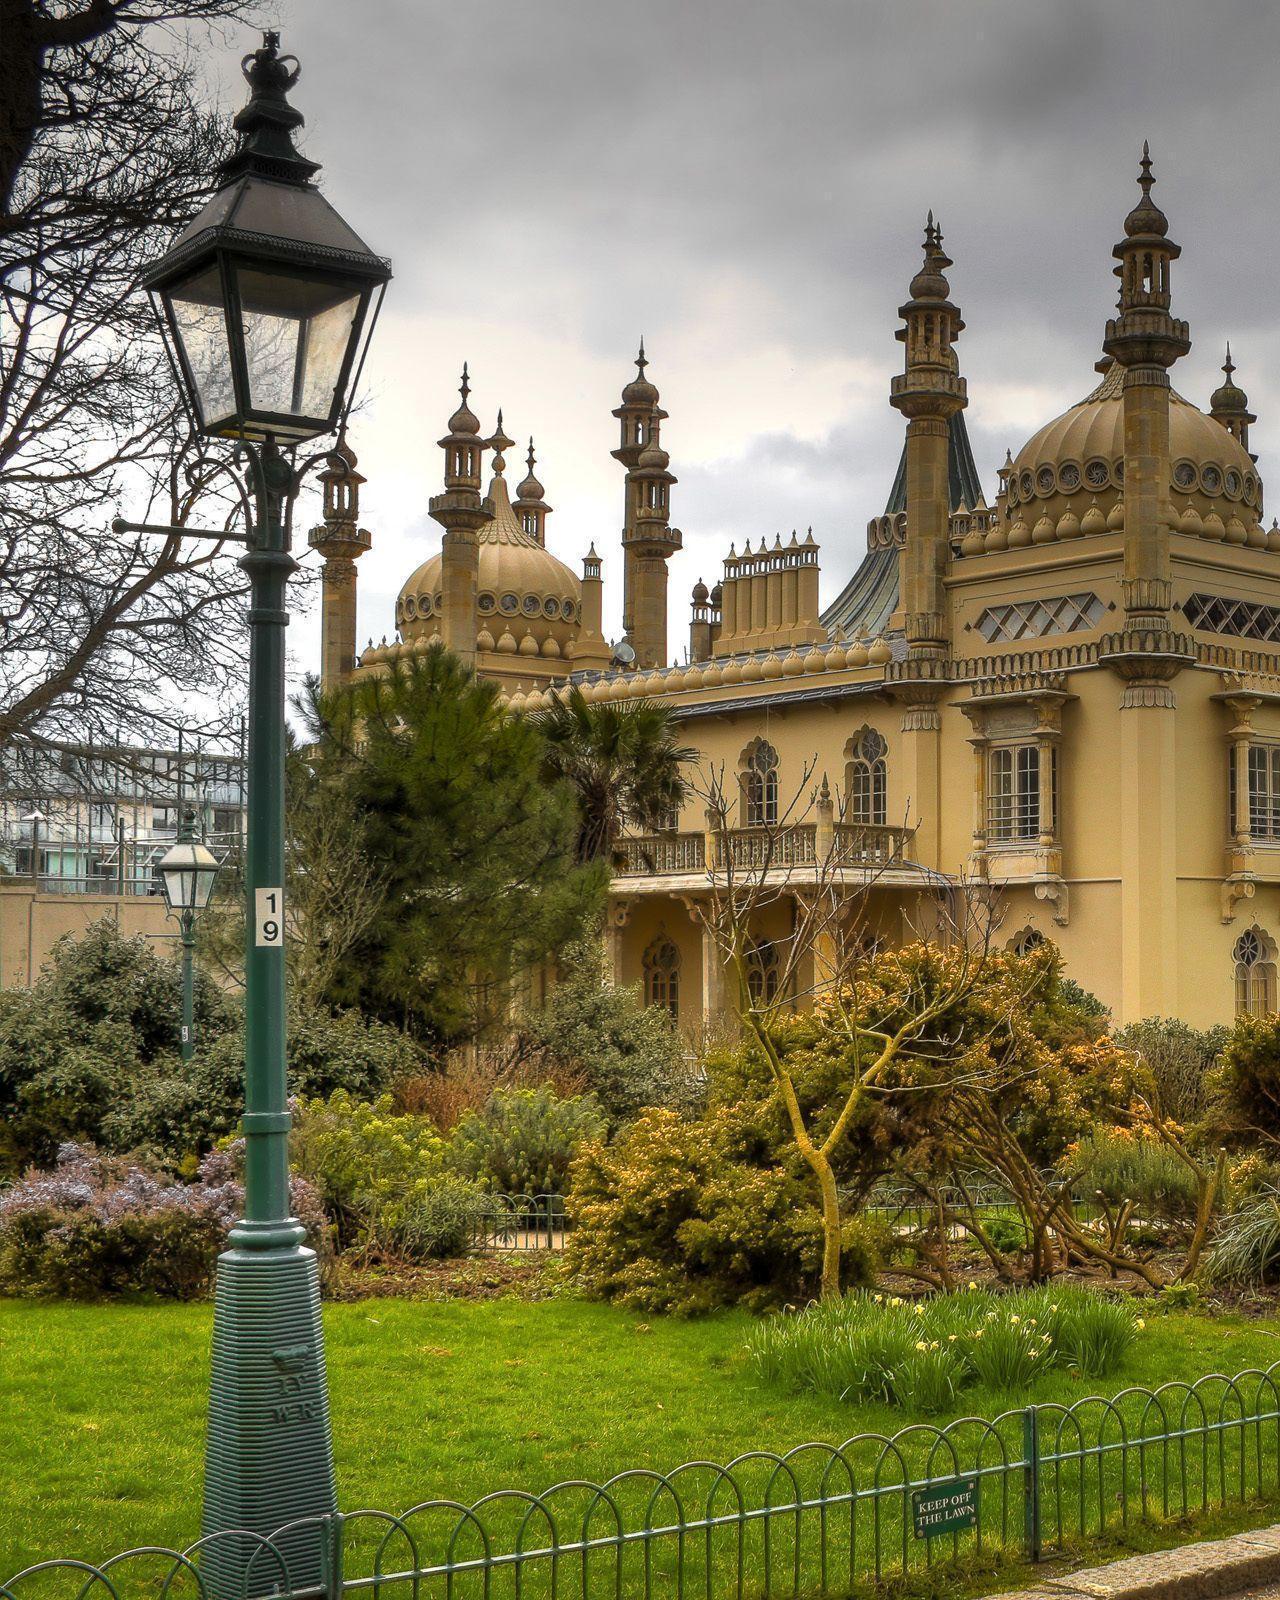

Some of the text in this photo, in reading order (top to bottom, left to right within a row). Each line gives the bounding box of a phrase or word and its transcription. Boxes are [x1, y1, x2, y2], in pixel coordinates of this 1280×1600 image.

[919, 1491, 972, 1513] KEEP OFF
[916, 1503, 976, 1526] THE LAWN
